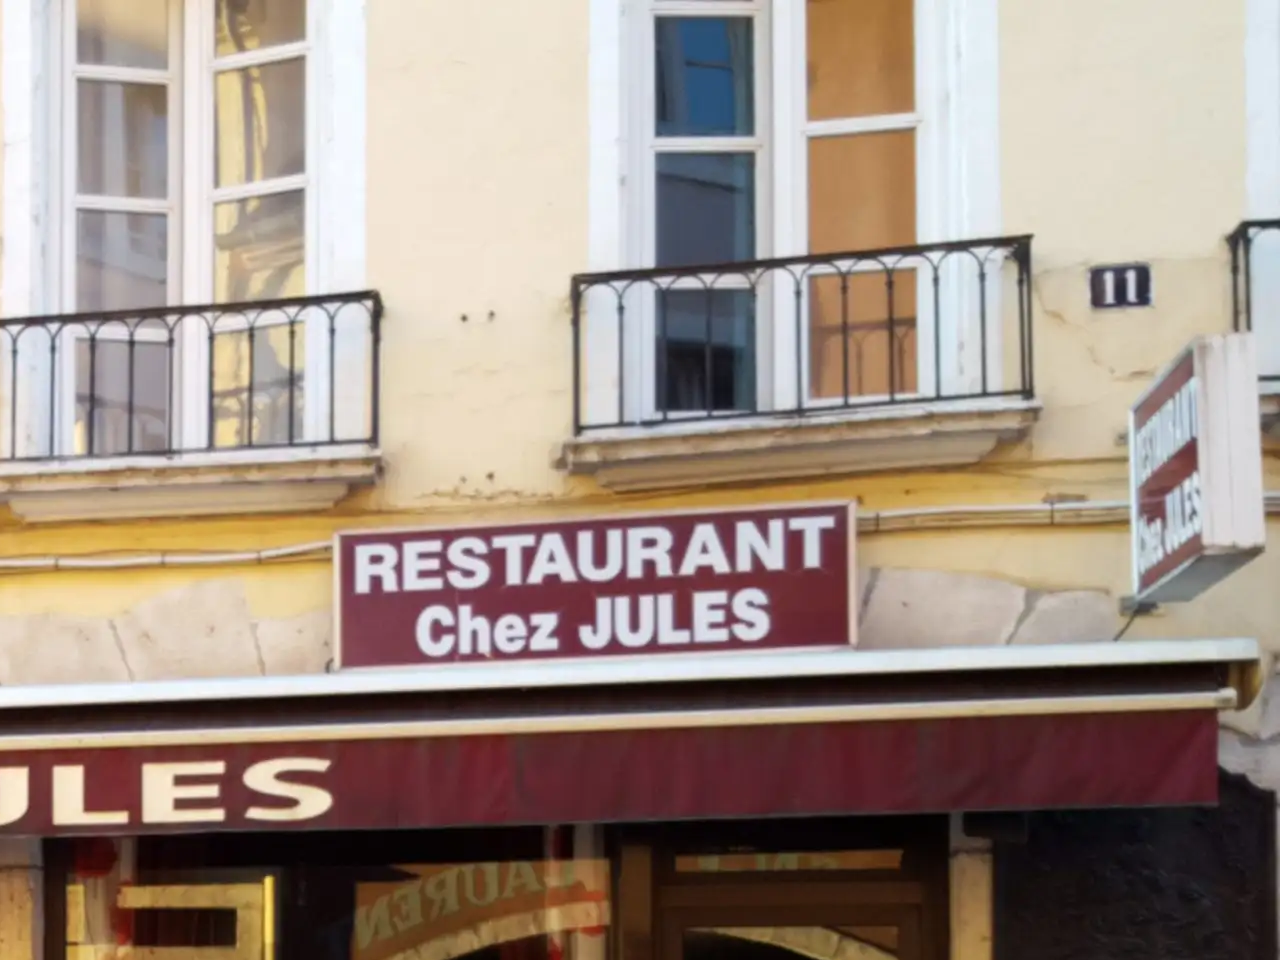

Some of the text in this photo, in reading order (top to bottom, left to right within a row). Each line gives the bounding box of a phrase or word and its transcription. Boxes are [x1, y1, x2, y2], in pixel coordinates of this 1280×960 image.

[1103, 268, 1139, 305] 11
[353, 515, 836, 594] RESTAURANT
[415, 587, 772, 658] Chez JULES
